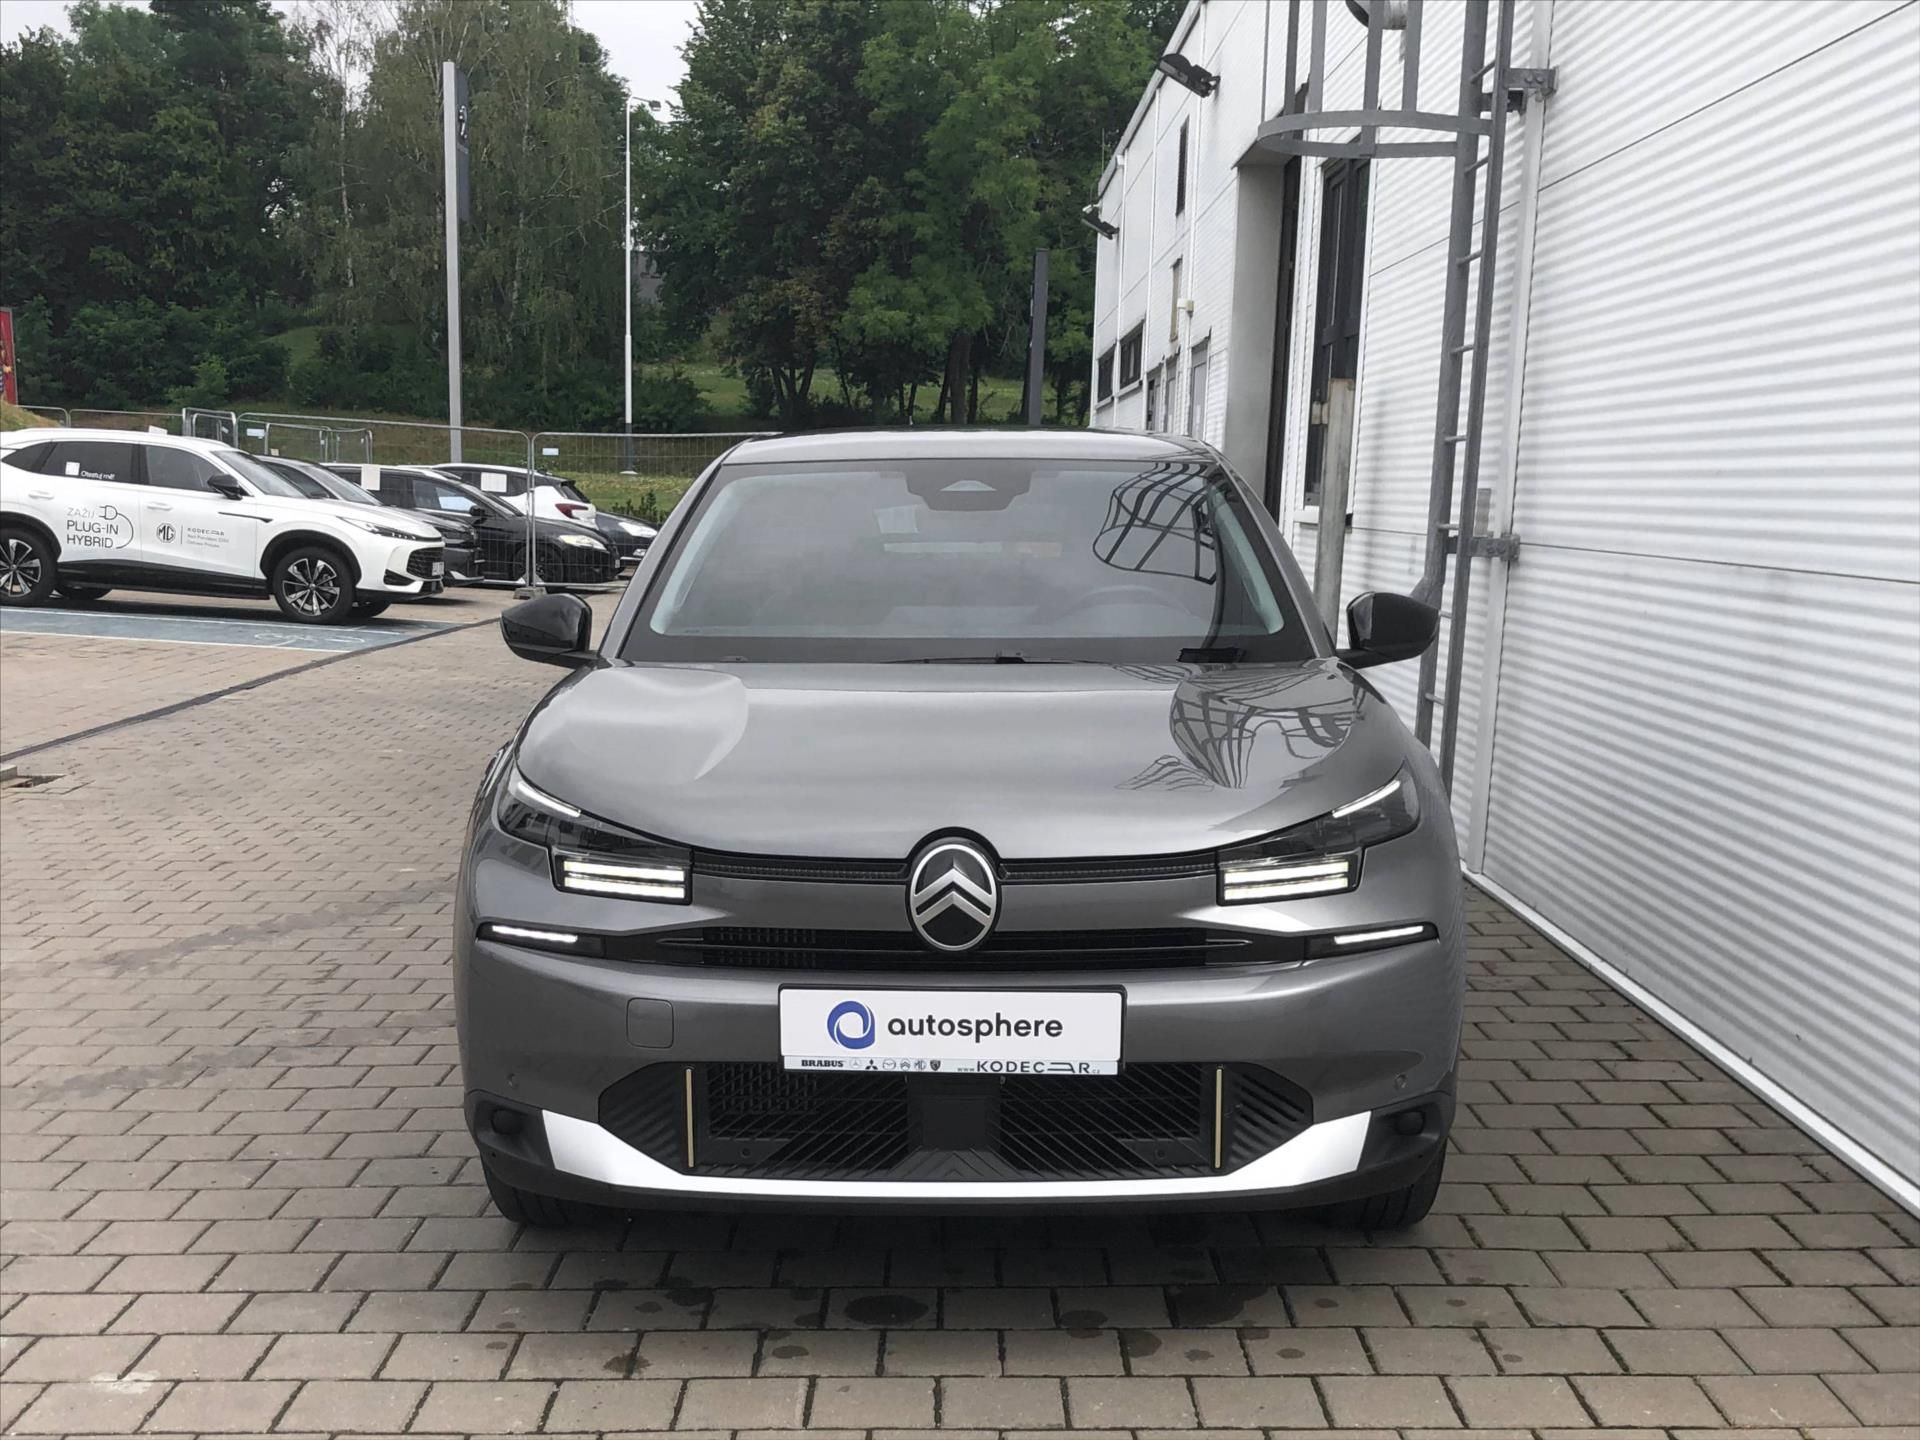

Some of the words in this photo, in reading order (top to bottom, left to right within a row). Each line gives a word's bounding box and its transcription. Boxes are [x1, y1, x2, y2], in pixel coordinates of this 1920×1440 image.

[66, 519, 119, 535] PLUG-IN
[157, 523, 175, 542] MG
[66, 533, 114, 549] HYBRID
[887, 1012, 1064, 1044] autosphere
[800, 1059, 845, 1068] BRABUS
